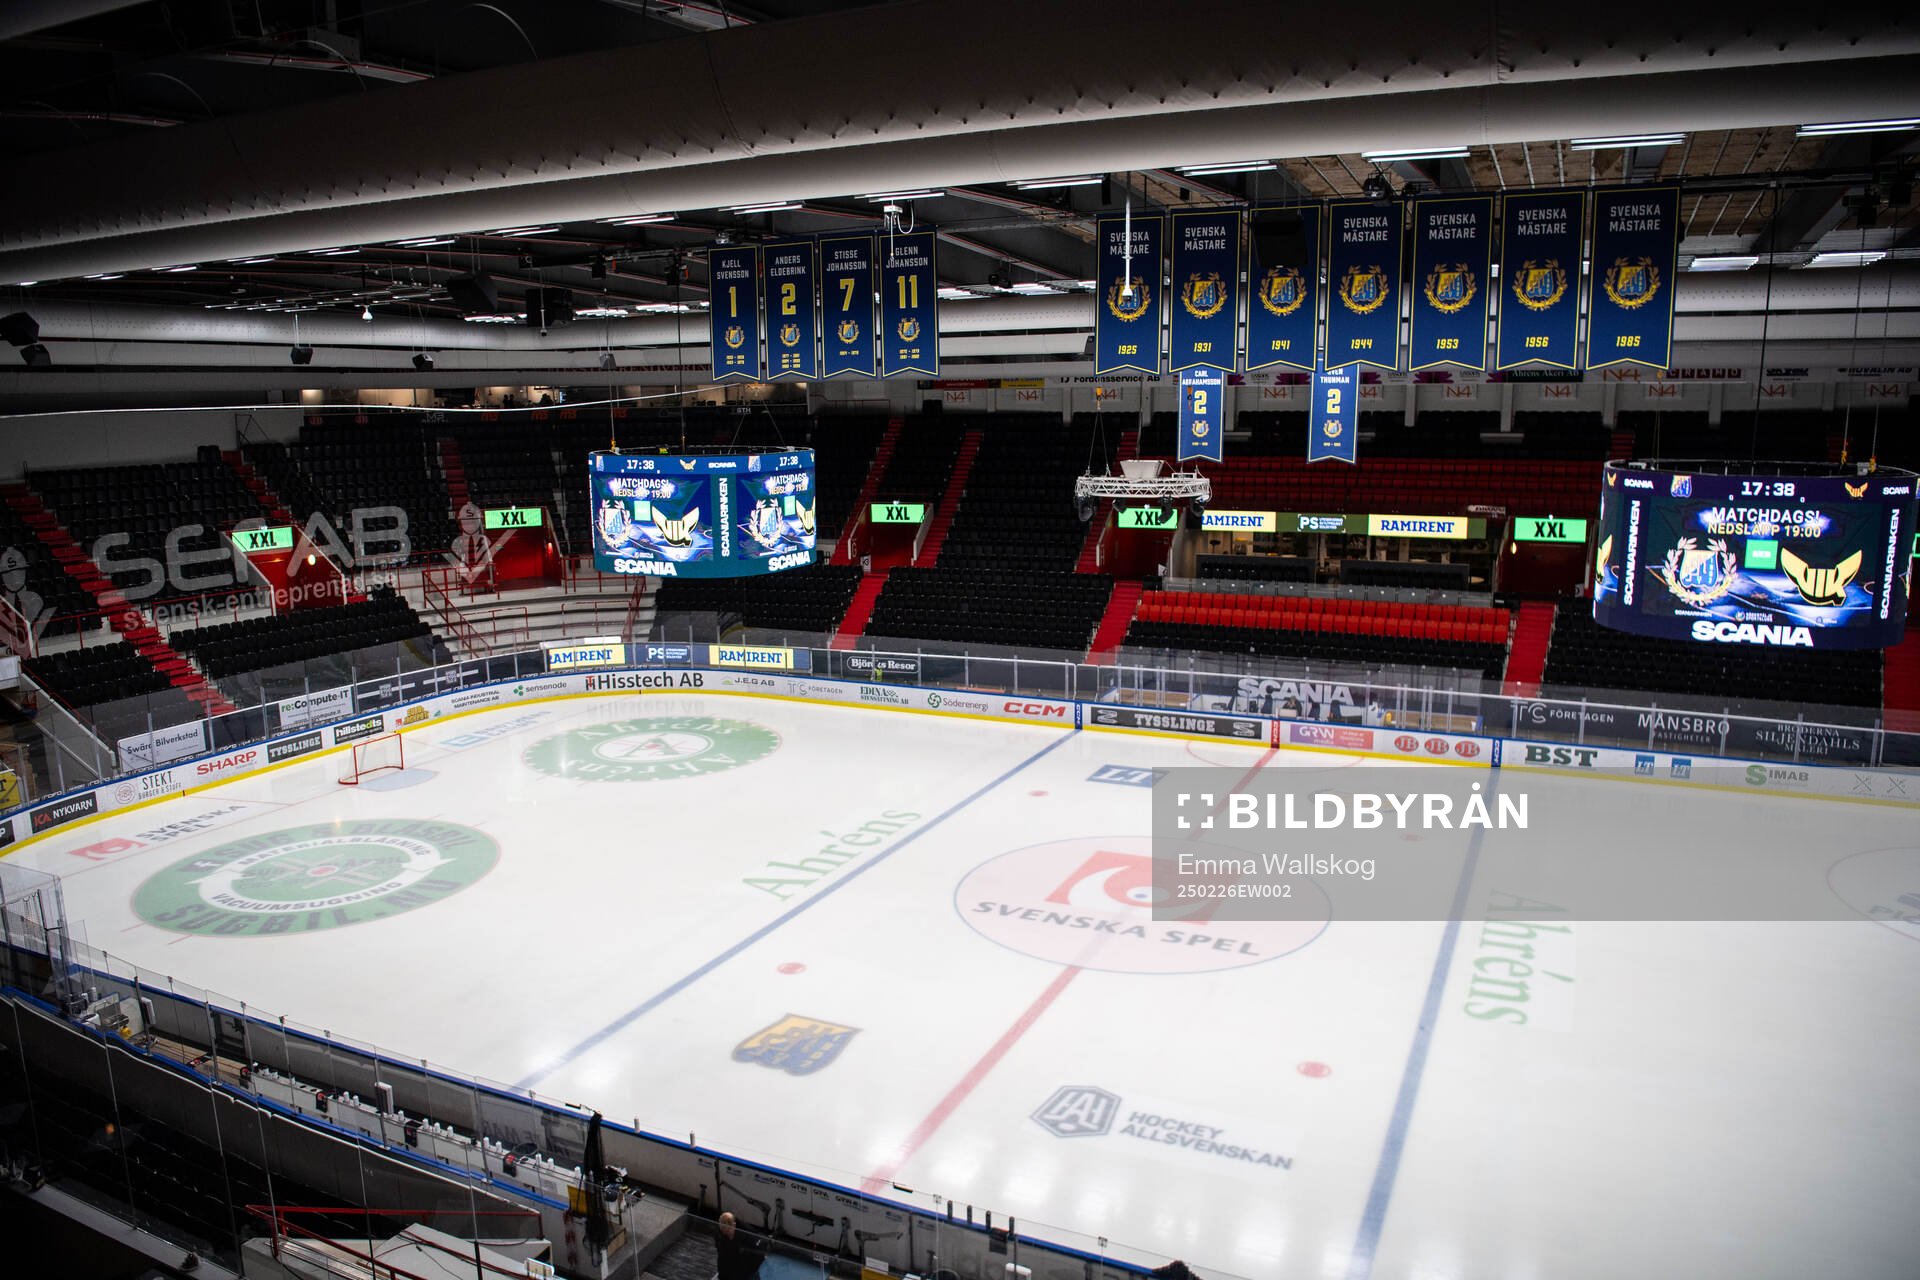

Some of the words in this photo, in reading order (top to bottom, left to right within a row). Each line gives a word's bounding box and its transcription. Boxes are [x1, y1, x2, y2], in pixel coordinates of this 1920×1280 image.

[1518, 208, 1566, 221] SVENSKA
[1610, 204, 1661, 217] SVENSKA
[1344, 217, 1388, 228] SVENSKA
[1429, 214, 1476, 225] SVENSKA
[1609, 218, 1660, 232] MÄSTARE
[1185, 226, 1226, 237] SVENSKA
[1344, 230, 1388, 242] MÄSTARE
[1429, 227, 1476, 239] MÄSTARE
[1518, 223, 1566, 235] MÄSTARE
[895, 247, 918, 255] GLENN
[1185, 238, 1226, 250] MÄSTARE
[775, 255, 801, 265] ANDERS
[834, 250, 858, 259] STISSE
[722, 259, 741, 268] KJELL
[826, 261, 867, 272] JOHANSSON
[886, 257, 928, 269] JOHANSSON
[716, 270, 749, 280] SVENSSON
[771, 266, 806, 277] ELDEBRINK
[840, 279, 855, 311] 7
[897, 275, 918, 308] 11
[729, 286, 736, 317] 1
[781, 283, 796, 315] 2
[1194, 342, 1211, 352] 1931
[1272, 340, 1290, 350] 1941
[1351, 339, 1372, 350] 1944
[1436, 339, 1458, 349] 1953
[1525, 336, 1549, 347] 1956
[1616, 336, 1640, 347] 1985
[1118, 345, 1137, 355] 1925
[1194, 390, 1207, 414] 2
[1327, 389, 1341, 413] 2
[626, 460, 654, 470] 17:38
[709, 461, 736, 469] SCANIA
[780, 456, 798, 466] 17:38
[1624, 479, 1653, 489] SCANIA
[1741, 482, 1795, 496] 17:38
[1883, 486, 1909, 495] SCANIA
[501, 511, 529, 526] XXL
[719, 478, 730, 557] SCANIARINKEN
[886, 507, 910, 520] XXL
[1712, 507, 1820, 524] MATCHDAGS!
[1300, 516, 1319, 529] PS
[1381, 520, 1454, 534] RAMIRENT
[1534, 521, 1566, 538] XXL
[1785, 524, 1821, 538] 19:00
[250, 532, 277, 548] XXL
[1624, 500, 1641, 606] SCANIARINKEN
[614, 559, 677, 576] SCANIA
[768, 551, 810, 572] SCANIA
[1880, 509, 1899, 620] SCANIARINKEN
[1692, 621, 1813, 647] SCANIA
[648, 647, 664, 659] PS
[720, 649, 782, 664] RAMIRENT
[888, 661, 915, 670] Resor
[526, 681, 567, 692] sensenode
[598, 673, 675, 689] Hisstech
[680, 673, 704, 687] AB
[860, 687, 888, 697] EDINA
[1238, 679, 1354, 705] SCANIA
[943, 697, 988, 712] Söderenergi
[1004, 702, 1066, 717] CCM
[335, 718, 382, 738] hillstedts
[1134, 713, 1215, 733] TYSSLINGE
[1638, 713, 1730, 734] MÅNSBRO
[1299, 726, 1334, 740] GRW
[270, 736, 321, 758] TYSSLINGE
[1525, 744, 1598, 767] BST
[197, 751, 256, 776] SHARP
[142, 771, 172, 790] STEKT
[53, 799, 93, 819] NYKVARN
[136, 805, 246, 838] SVENSKA
[150, 823, 214, 842] SPEL
[212, 881, 403, 912] VACUUMSUGNING
[971, 901, 1147, 938] SVENSKA
[1160, 930, 1260, 956] SPEL
[1129, 1111, 1223, 1139] HOCKEY
[1120, 1124, 1294, 1170] ALLSVENSKAN
